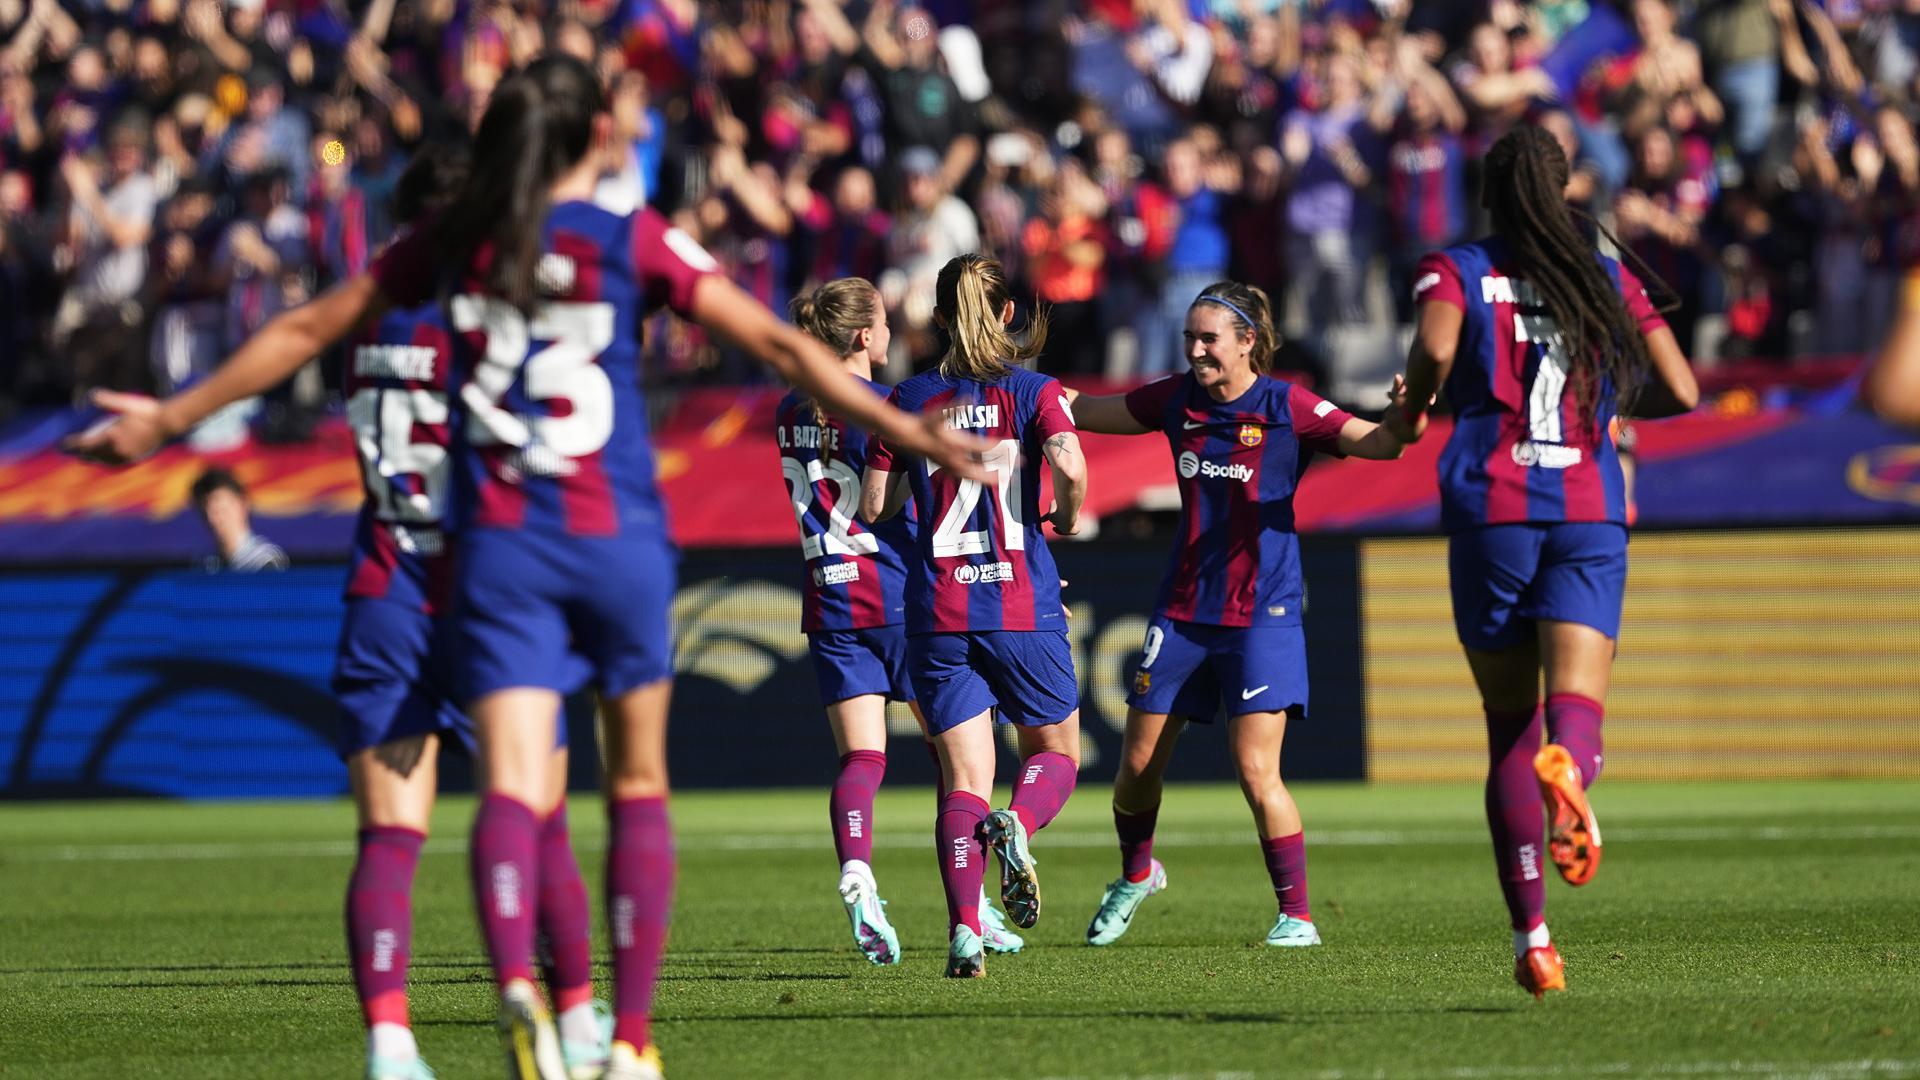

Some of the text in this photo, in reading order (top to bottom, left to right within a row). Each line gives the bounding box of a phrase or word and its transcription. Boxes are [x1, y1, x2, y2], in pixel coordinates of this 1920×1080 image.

[450, 294, 615, 458] 23
[1514, 313, 1572, 443] 7
[793, 425, 839, 451] BATE
[1201, 460, 1254, 483] Spotify
[780, 456, 880, 561] 22
[926, 439, 1025, 558] 21
[980, 562, 1012, 572] UNHCR
[980, 570, 1014, 581] ACNUR
[1144, 626, 1165, 668] 9
[953, 836, 971, 869] BARÇA
